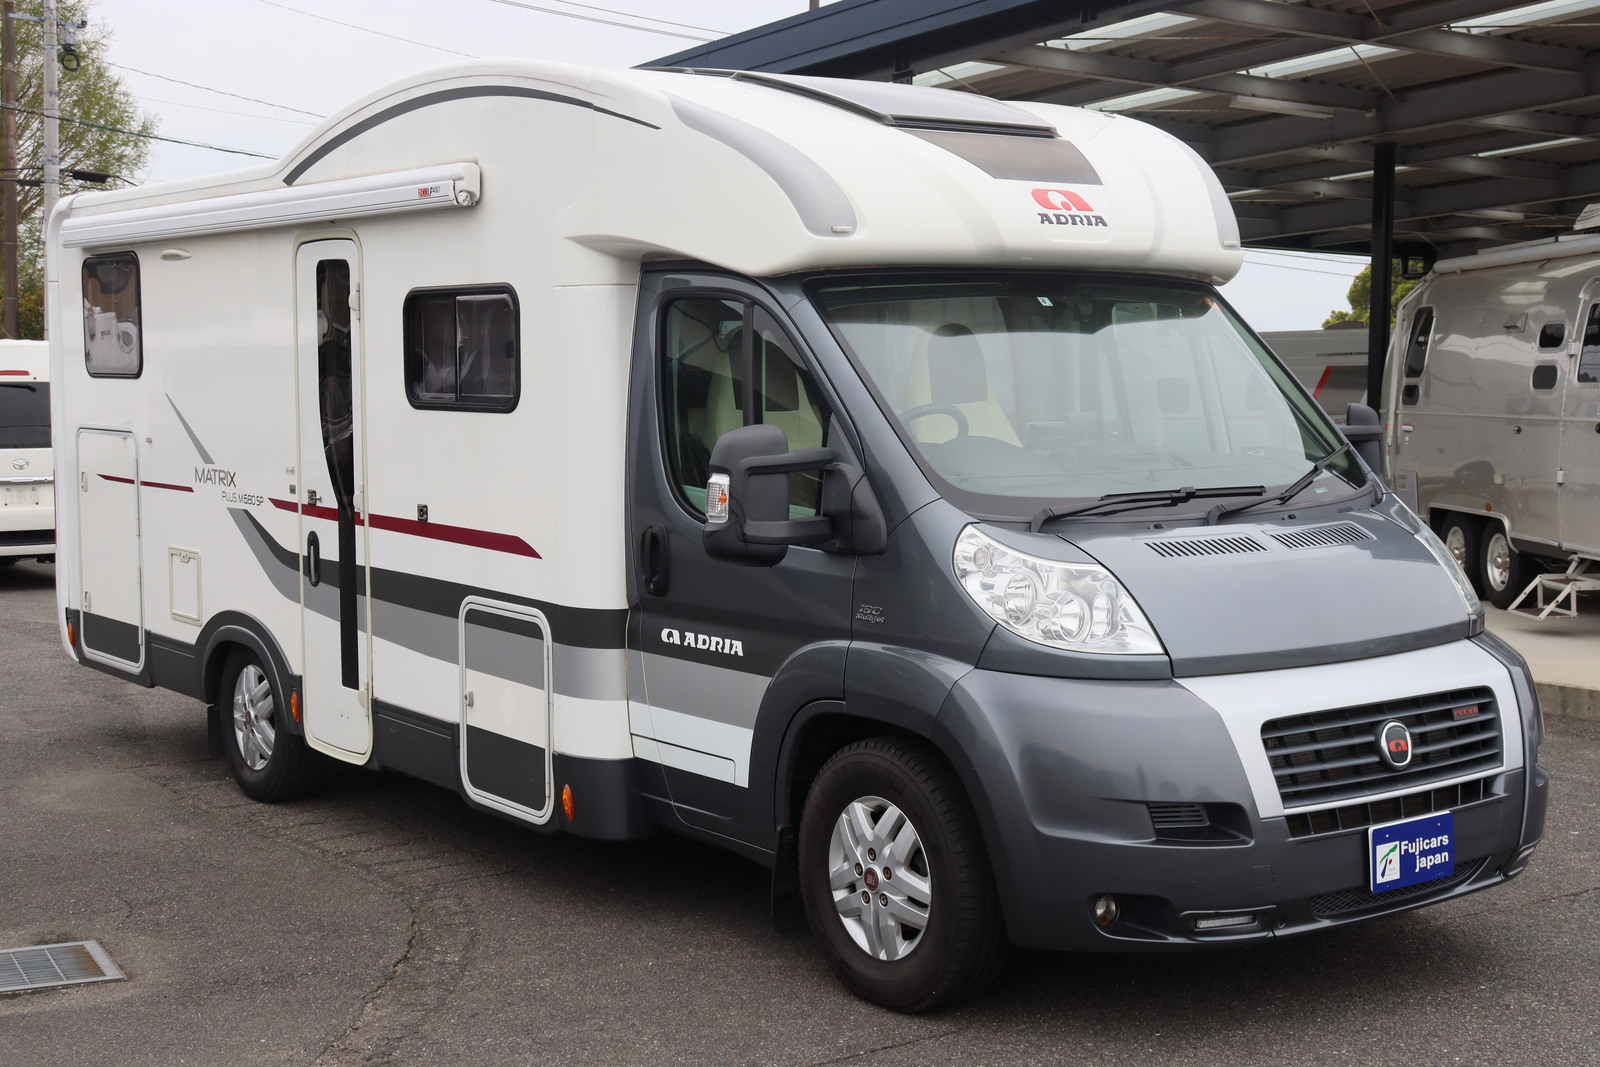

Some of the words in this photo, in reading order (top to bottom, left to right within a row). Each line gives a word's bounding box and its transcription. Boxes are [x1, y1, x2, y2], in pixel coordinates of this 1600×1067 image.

[1037, 212, 1108, 227] ADRIA
[194, 466, 237, 488] MATRIX
[221, 490, 238, 503] PLUS
[683, 631, 744, 657] ADRIA
[1400, 834, 1449, 855] Fujicars
[1414, 851, 1449, 873] japan
